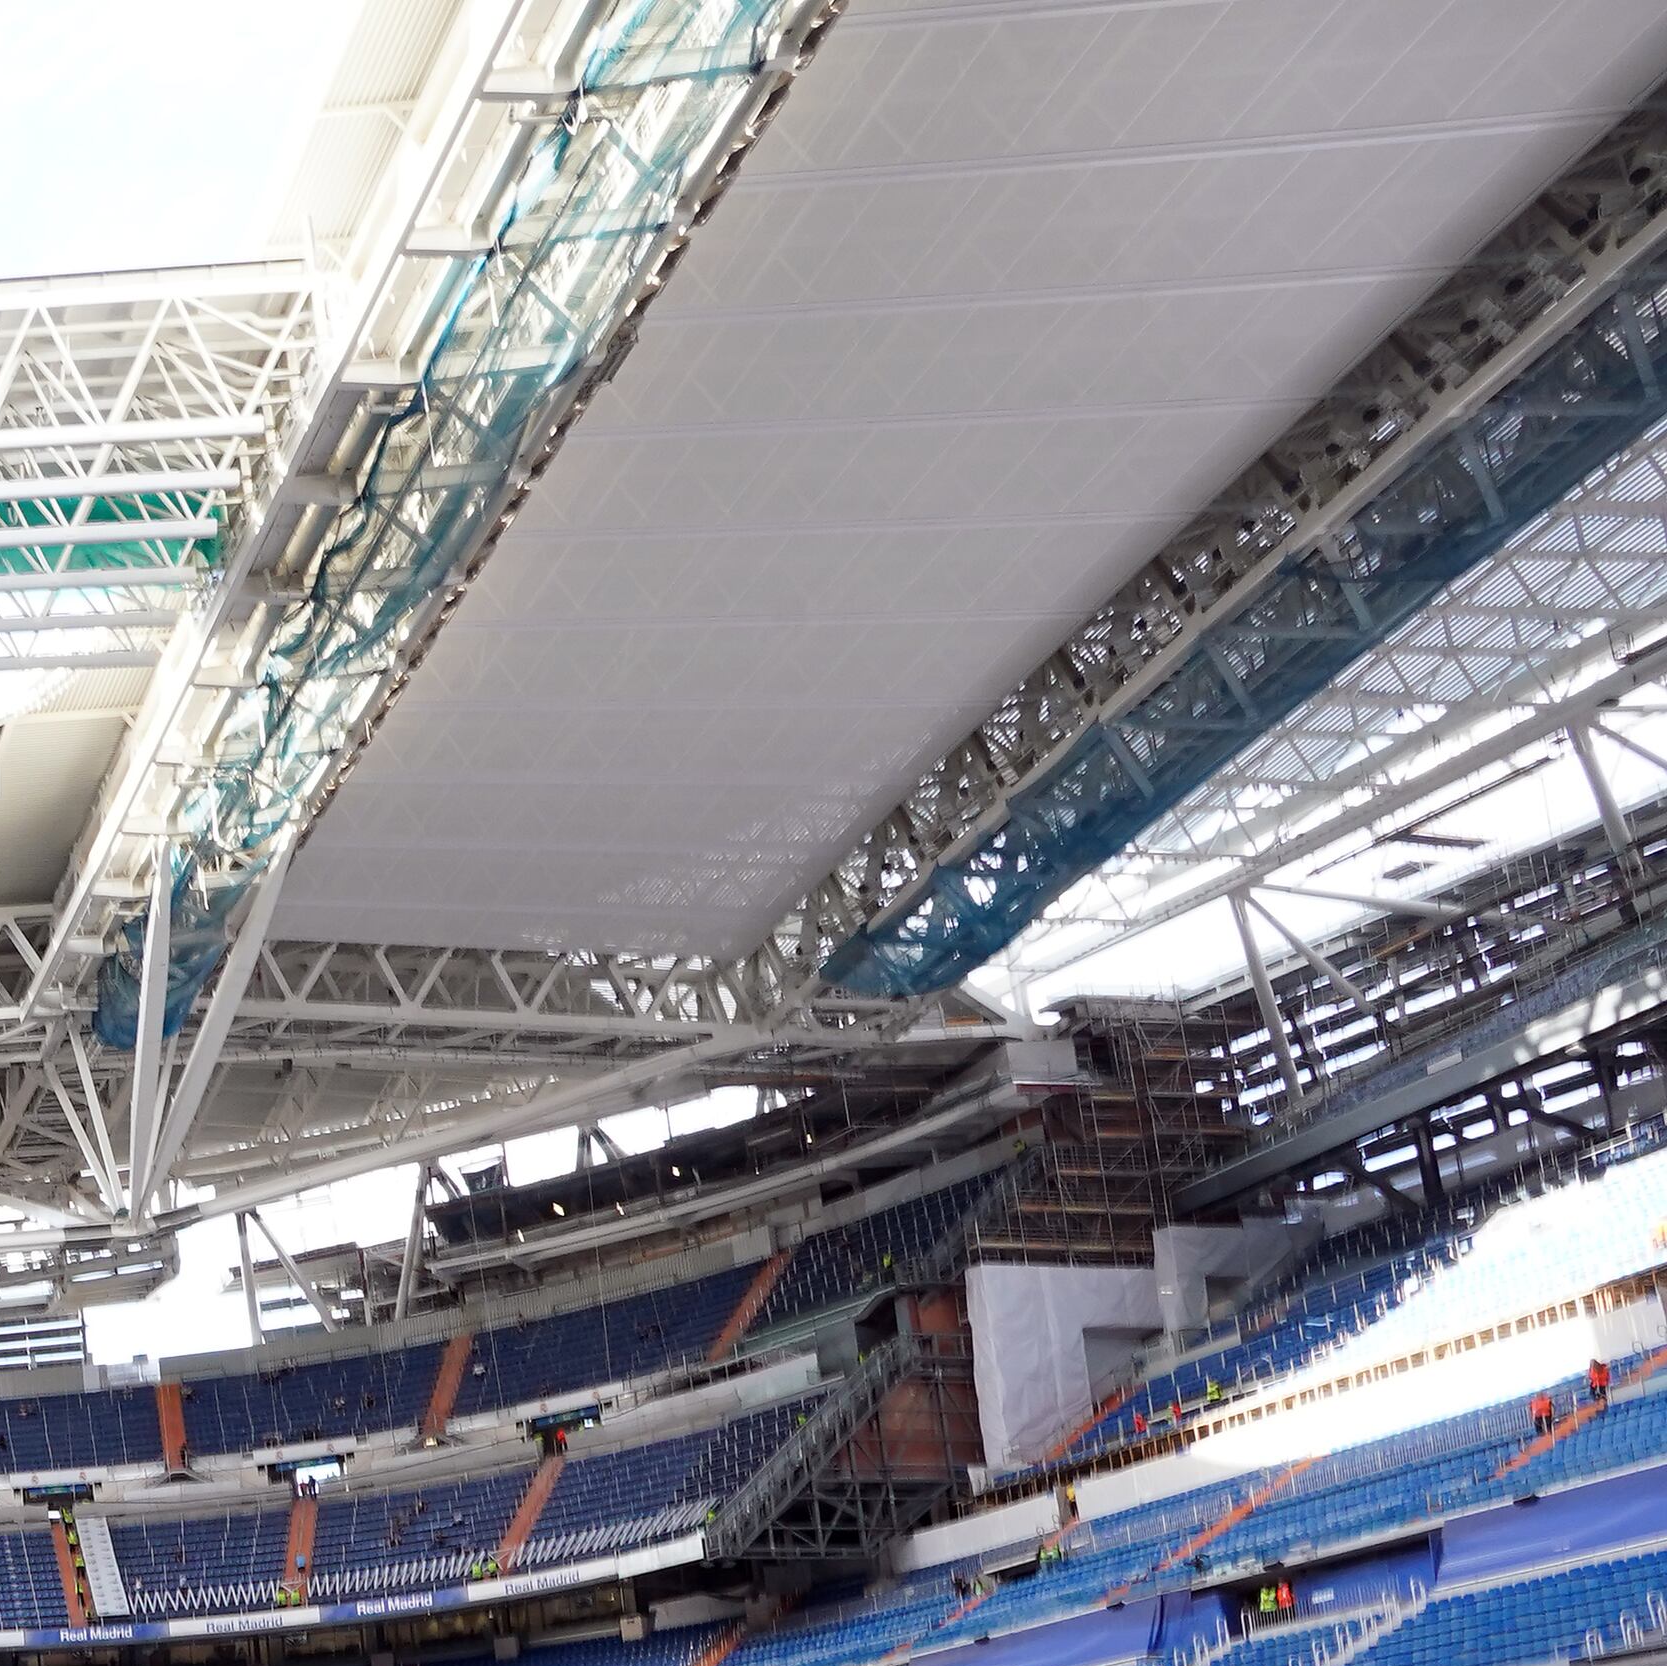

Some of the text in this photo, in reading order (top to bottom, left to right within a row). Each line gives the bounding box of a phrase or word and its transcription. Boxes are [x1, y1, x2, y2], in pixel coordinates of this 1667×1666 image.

[505, 1572, 580, 1595] Real Madrid
[357, 1594, 433, 1616] Real Madrid
[60, 1627, 133, 1642] Real Madrid
[206, 1617, 283, 1634] Real Madrid
